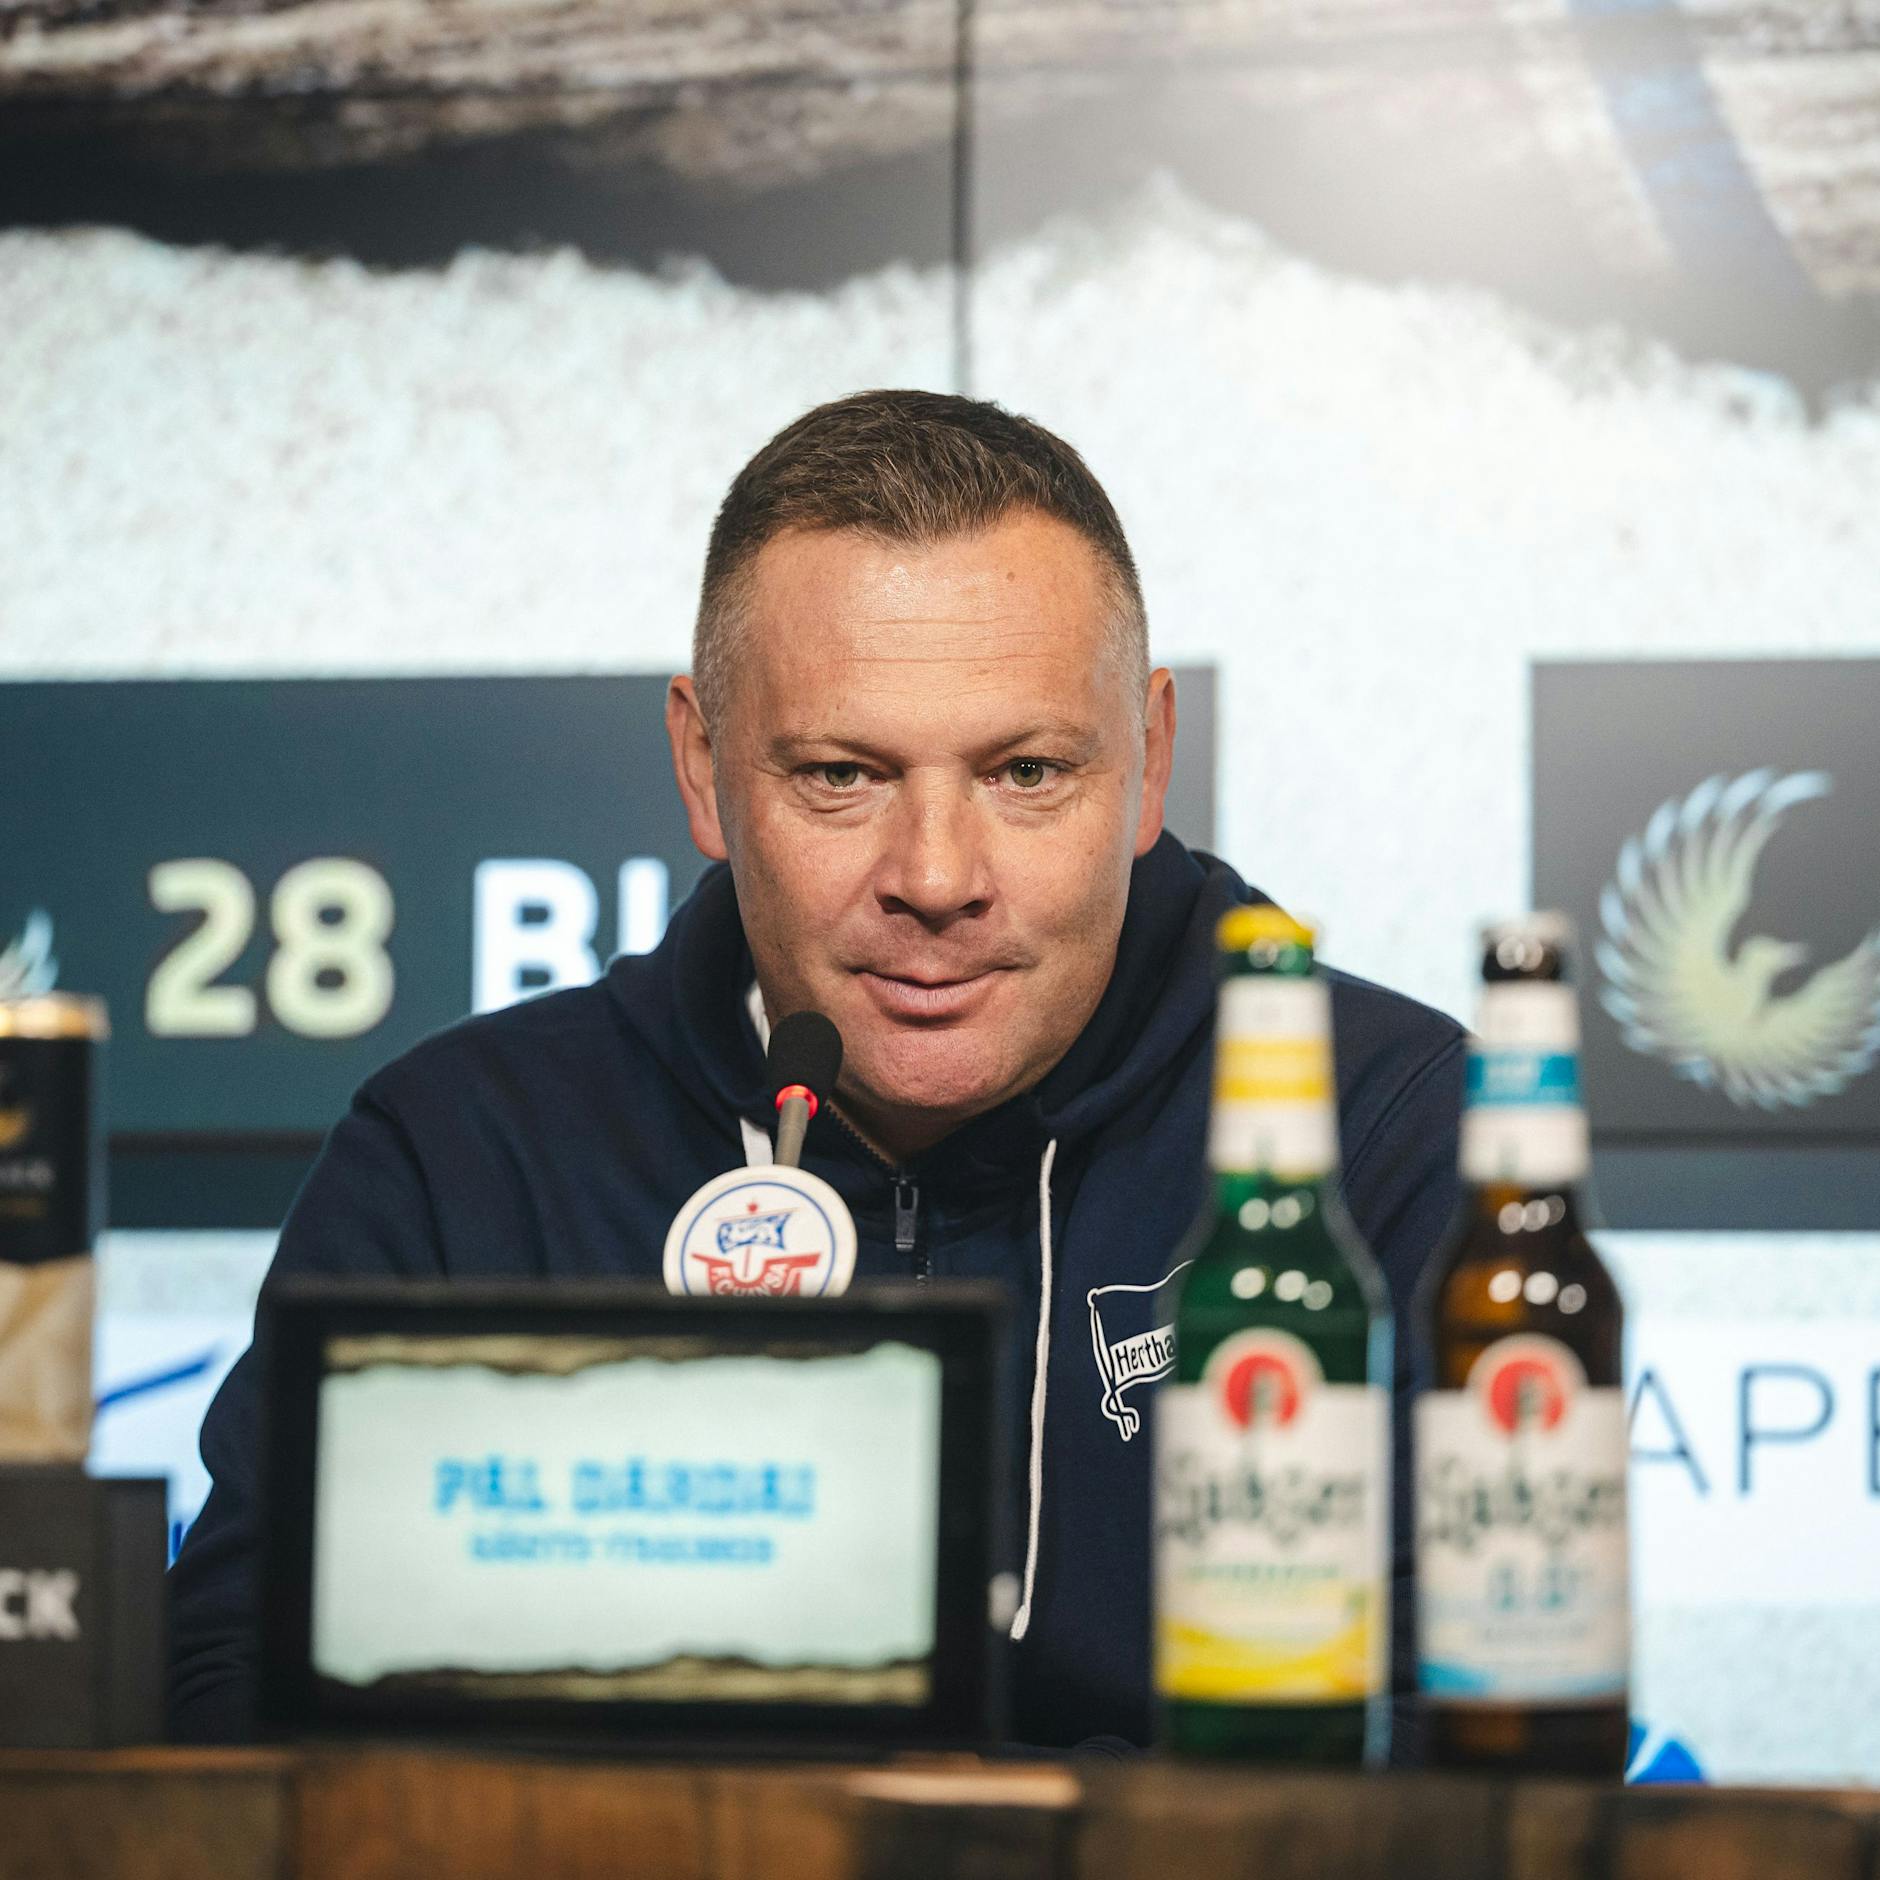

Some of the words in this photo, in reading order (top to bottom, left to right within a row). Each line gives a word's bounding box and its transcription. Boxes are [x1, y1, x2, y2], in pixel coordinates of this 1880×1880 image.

[145, 856, 396, 1038] 28
[1115, 1333, 1176, 1378] Hertha
[1627, 1364, 1880, 1495] AP
